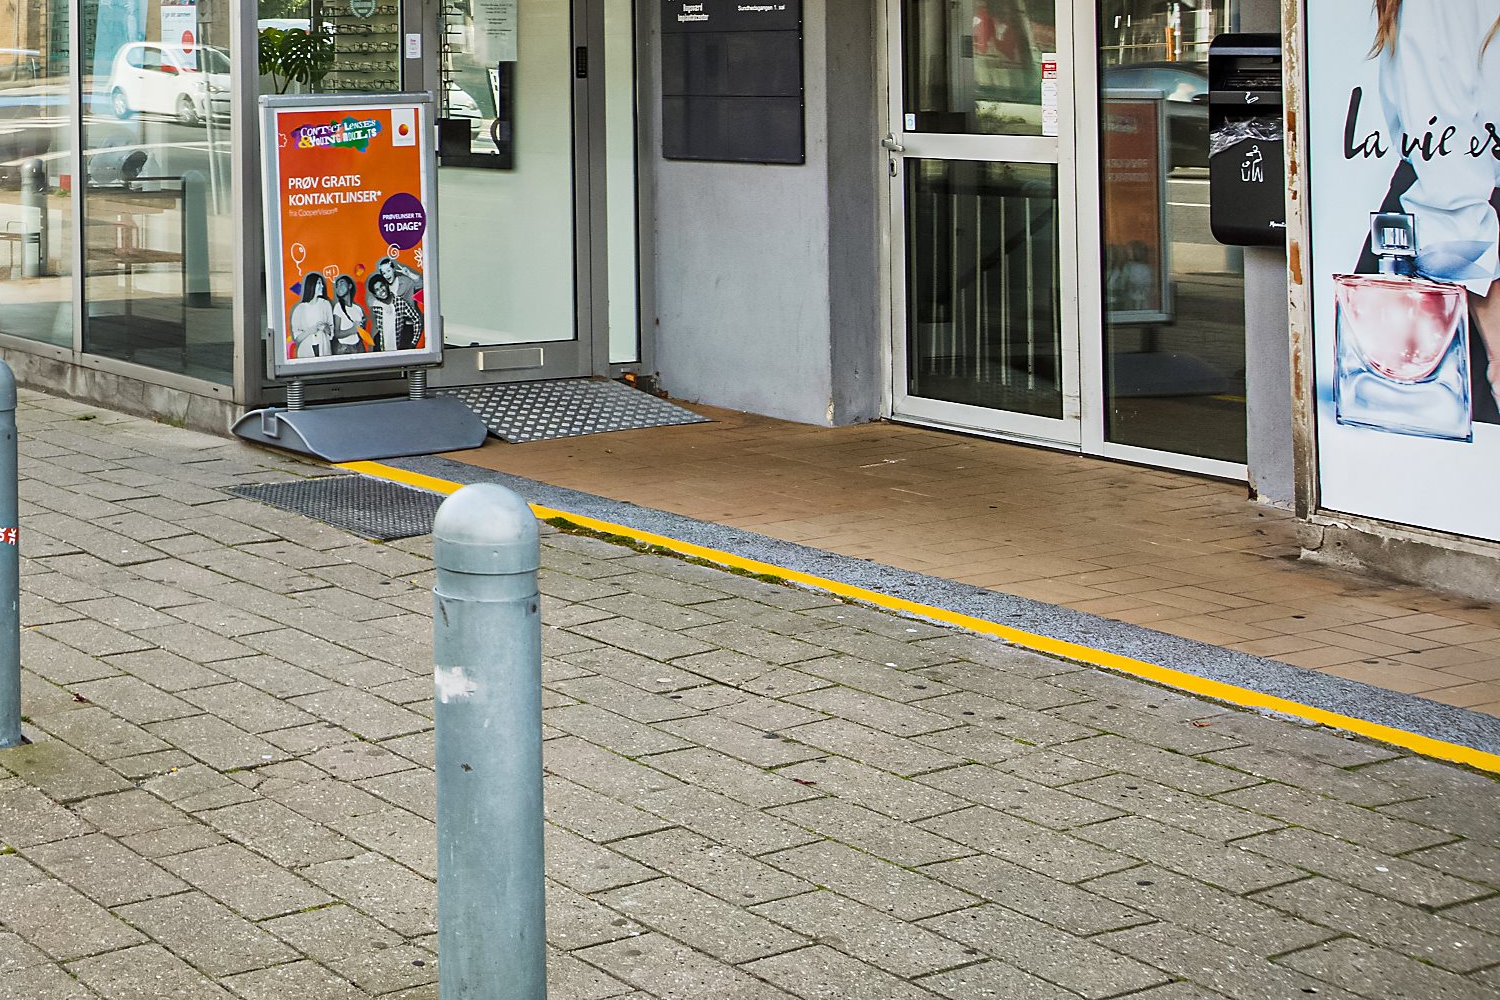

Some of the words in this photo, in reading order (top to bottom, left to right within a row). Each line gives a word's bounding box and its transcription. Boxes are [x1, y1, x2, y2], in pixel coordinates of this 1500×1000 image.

[1343, 86, 1389, 160] La
[1401, 115, 1457, 162] vie
[288, 176, 319, 190] PRØV
[321, 174, 361, 188] GRATIS
[384, 222, 395, 232] 10
